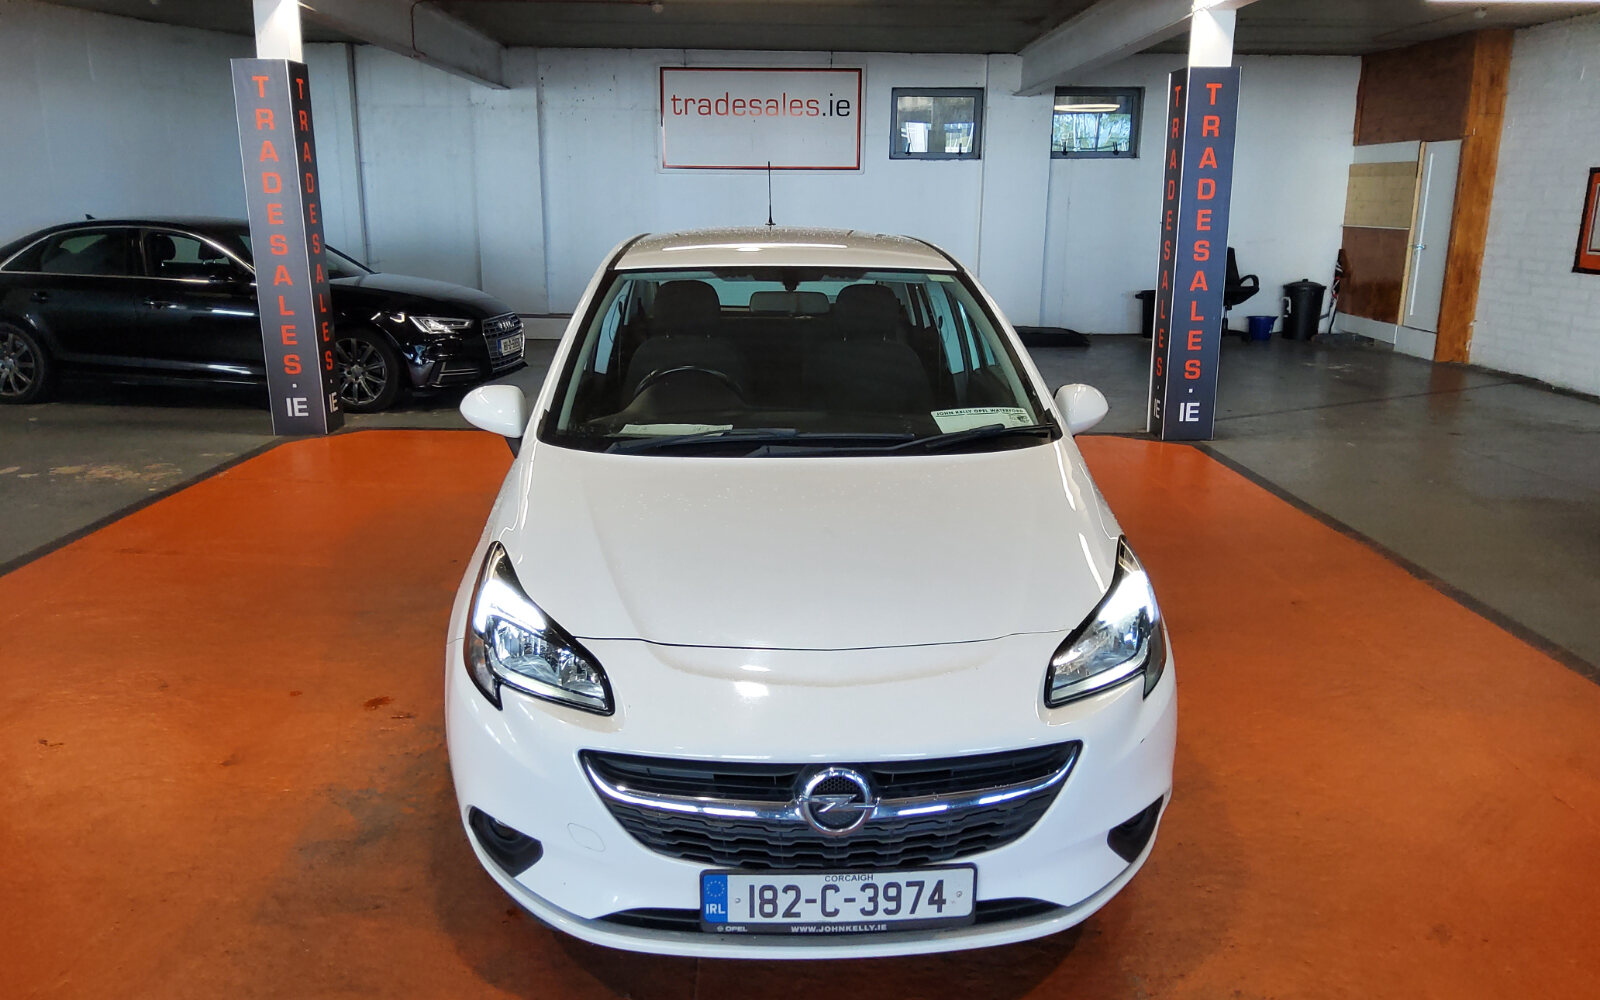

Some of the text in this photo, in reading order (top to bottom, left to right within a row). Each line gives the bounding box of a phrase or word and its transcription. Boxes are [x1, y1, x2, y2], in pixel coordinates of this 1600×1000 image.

[671, 92, 850, 117] tradesales.ie
[824, 874, 874, 883] CORCAIGH
[748, 879, 947, 919] 182-C-3974
[705, 903, 726, 915] IRL
[790, 923, 888, 934] WWW.JOHNKELLY.IE
